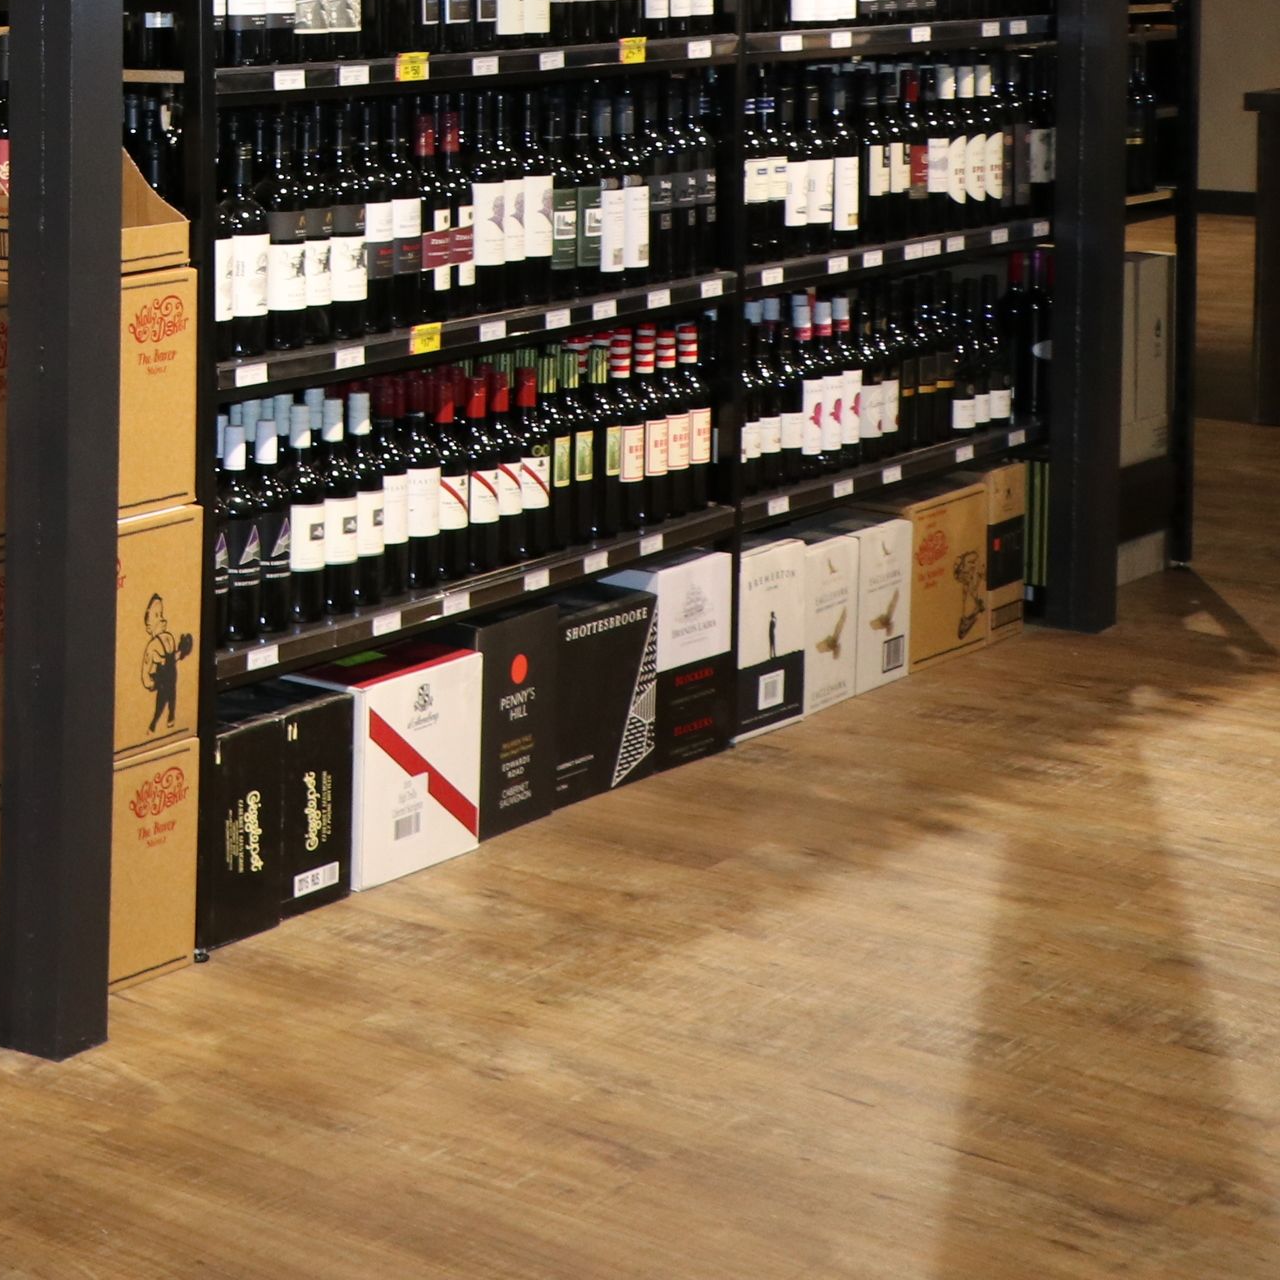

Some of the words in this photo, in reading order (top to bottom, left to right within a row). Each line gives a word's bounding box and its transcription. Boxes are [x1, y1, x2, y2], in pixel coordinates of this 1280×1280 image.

[137, 352, 151, 366] The
[565, 606, 648, 642] SHOTTESBROOKE
[500, 687, 536, 711] PENNY'S
[509, 708, 528, 721] HILL
[501, 755, 530, 773] EDWARDS
[507, 766, 525, 778] ROAD
[501, 781, 529, 799] CABERNET
[499, 791, 532, 809] SAUVIGNON
[137, 824, 152, 841] The
